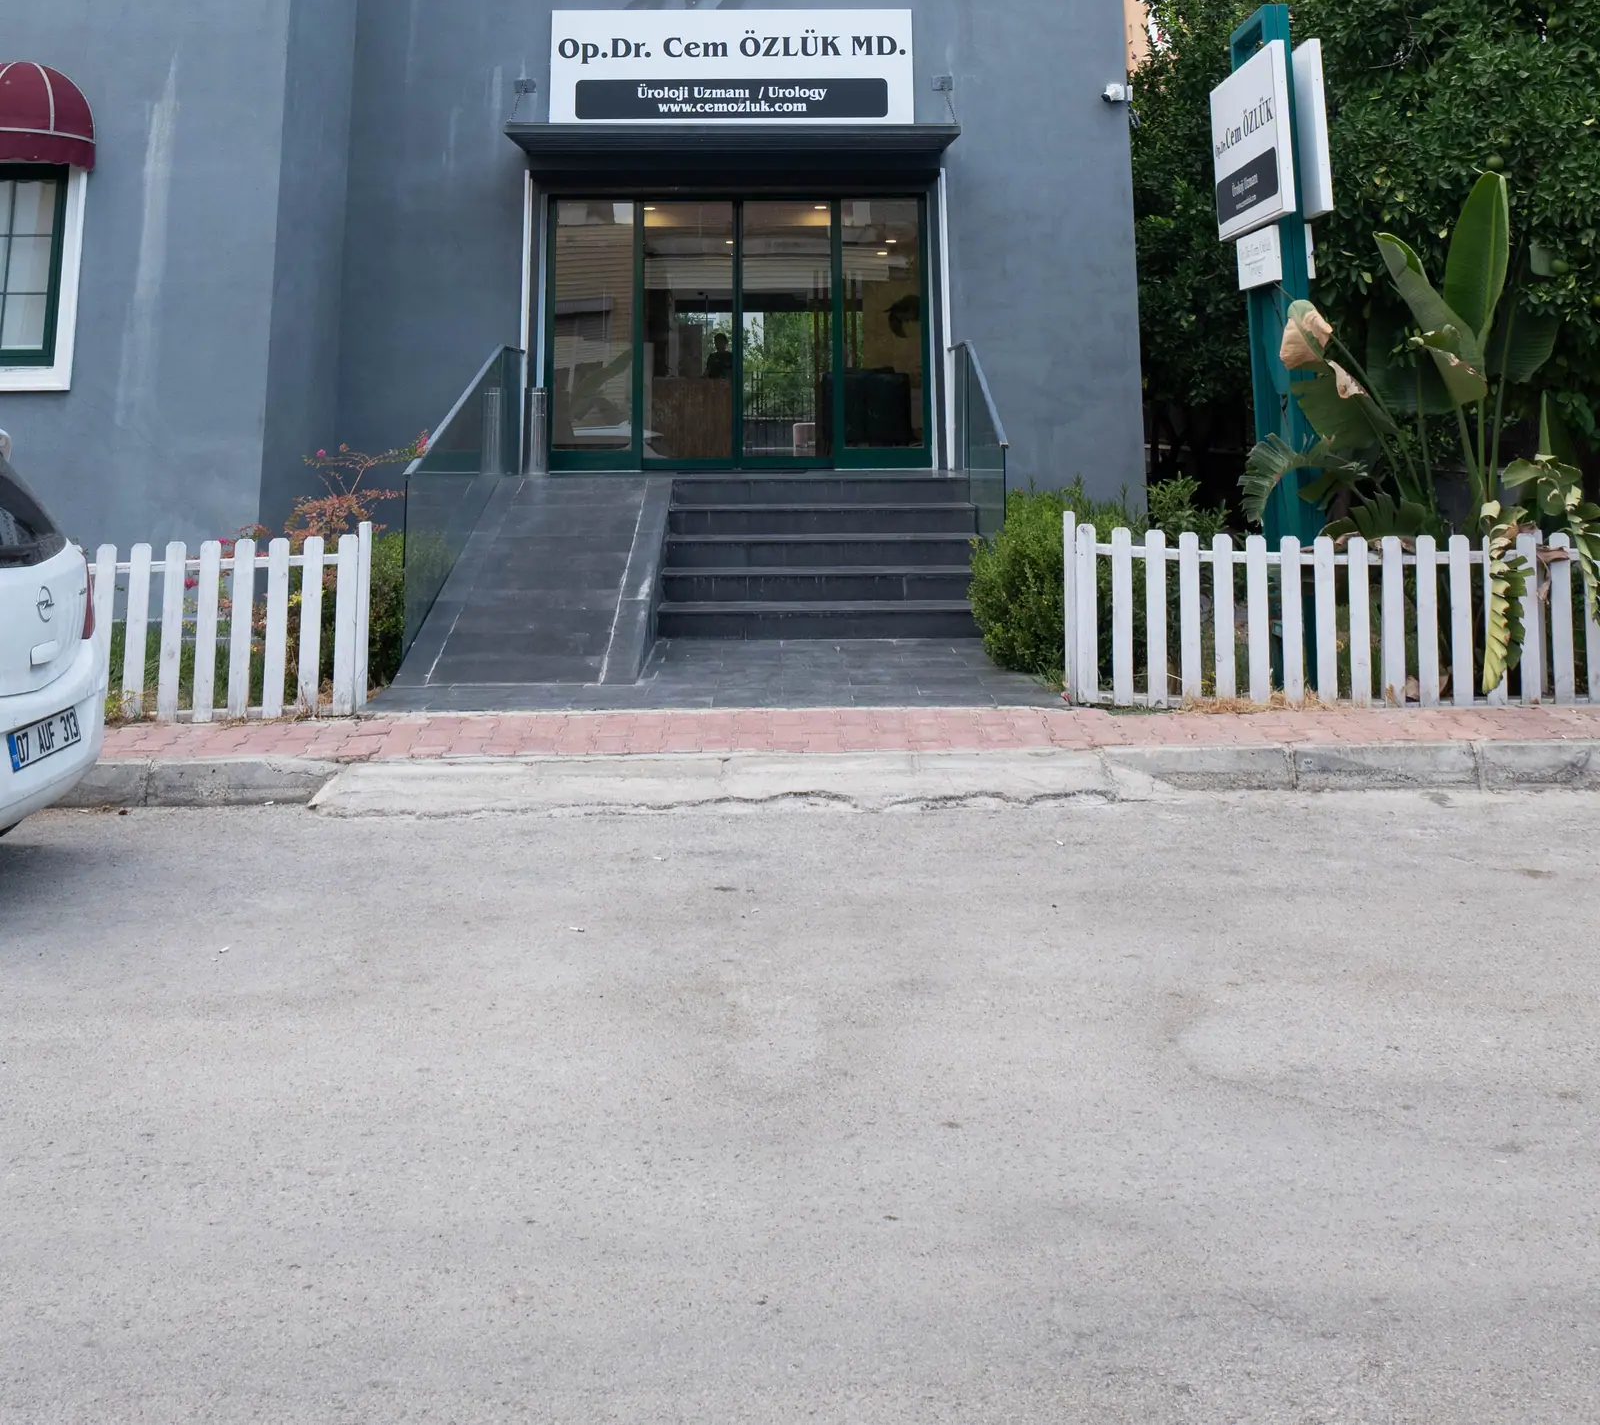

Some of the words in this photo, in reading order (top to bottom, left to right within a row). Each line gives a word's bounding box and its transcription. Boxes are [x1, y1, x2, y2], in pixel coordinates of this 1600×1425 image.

[558, 38, 652, 65] Op.Dr.
[663, 37, 729, 58] Cem
[739, 29, 842, 57] ÖZLÜK
[851, 35, 907, 56] MD.
[637, 83, 689, 101] Üroloji
[693, 86, 750, 99] Uzmanı
[758, 86, 765, 99] /
[768, 85, 828, 101] Urology
[657, 100, 807, 113] www.cemozluk.com
[1225, 126, 1242, 150] Cem
[1242, 96, 1274, 138] ÖZLÜK
[16, 731, 30, 763] 07
[37, 720, 55, 754] AUF
[60, 711, 79, 742] 313
